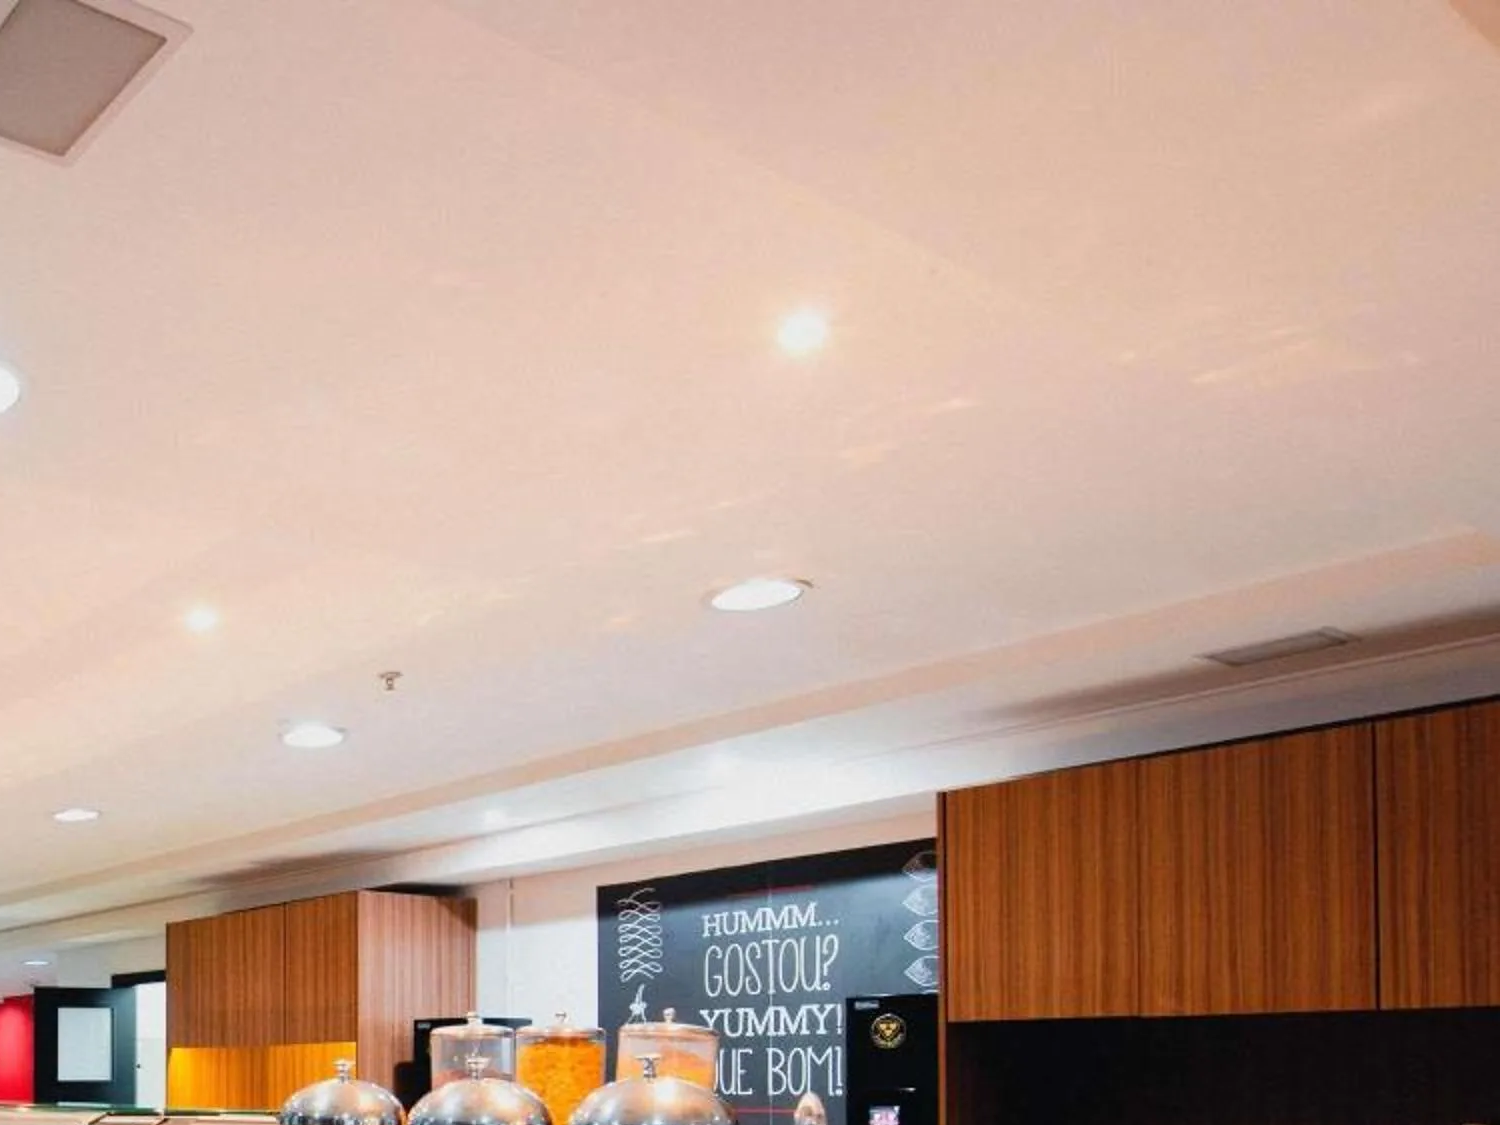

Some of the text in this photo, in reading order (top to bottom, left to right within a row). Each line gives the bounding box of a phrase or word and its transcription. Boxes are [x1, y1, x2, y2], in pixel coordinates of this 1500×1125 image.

[702, 902, 839, 937] HUMMM...
[705, 934, 839, 997] GOSTOU?
[700, 1003, 843, 1038] YUMMY!
[713, 1045, 843, 1097] UE BOM!
